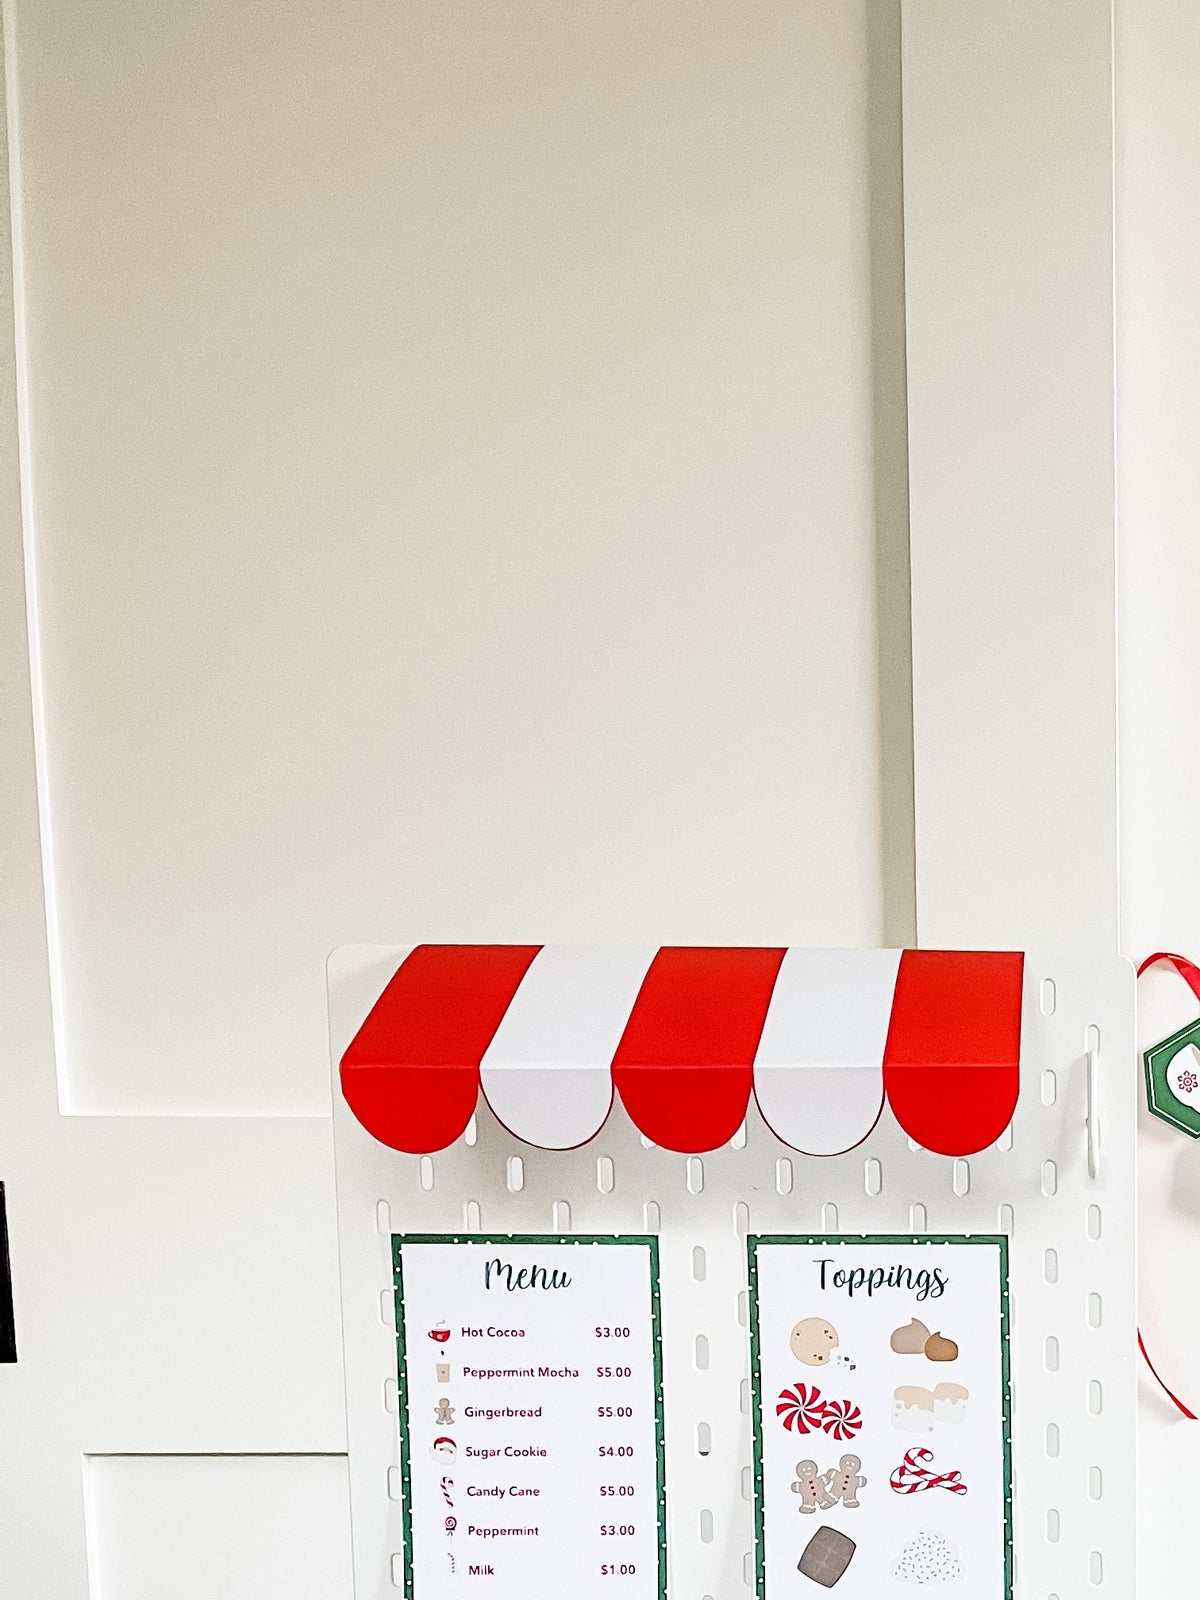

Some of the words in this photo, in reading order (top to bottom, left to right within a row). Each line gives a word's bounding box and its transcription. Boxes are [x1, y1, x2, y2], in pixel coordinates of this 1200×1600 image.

[484, 1257, 573, 1292] Menu
[812, 1259, 949, 1302] Toppings
[461, 1326, 484, 1338] Hot
[486, 1326, 526, 1338] Cocoa
[595, 1326, 631, 1338] $3.00
[463, 1366, 535, 1380] Peppermint
[538, 1366, 580, 1378] Mocha
[596, 1366, 632, 1378] $5.00
[464, 1406, 542, 1420] Gingerbread
[597, 1406, 633, 1418] $5.00
[465, 1446, 502, 1460] Sugar
[504, 1446, 547, 1457] Cookie
[598, 1446, 634, 1457] $4.00
[466, 1486, 506, 1500] Candy
[508, 1486, 540, 1497] Cane
[599, 1486, 635, 1497] $5.00
[468, 1525, 539, 1539] Peppermint
[600, 1525, 635, 1536] $3.00
[469, 1564, 495, 1576] Milk
[601, 1564, 636, 1576] $1.00
